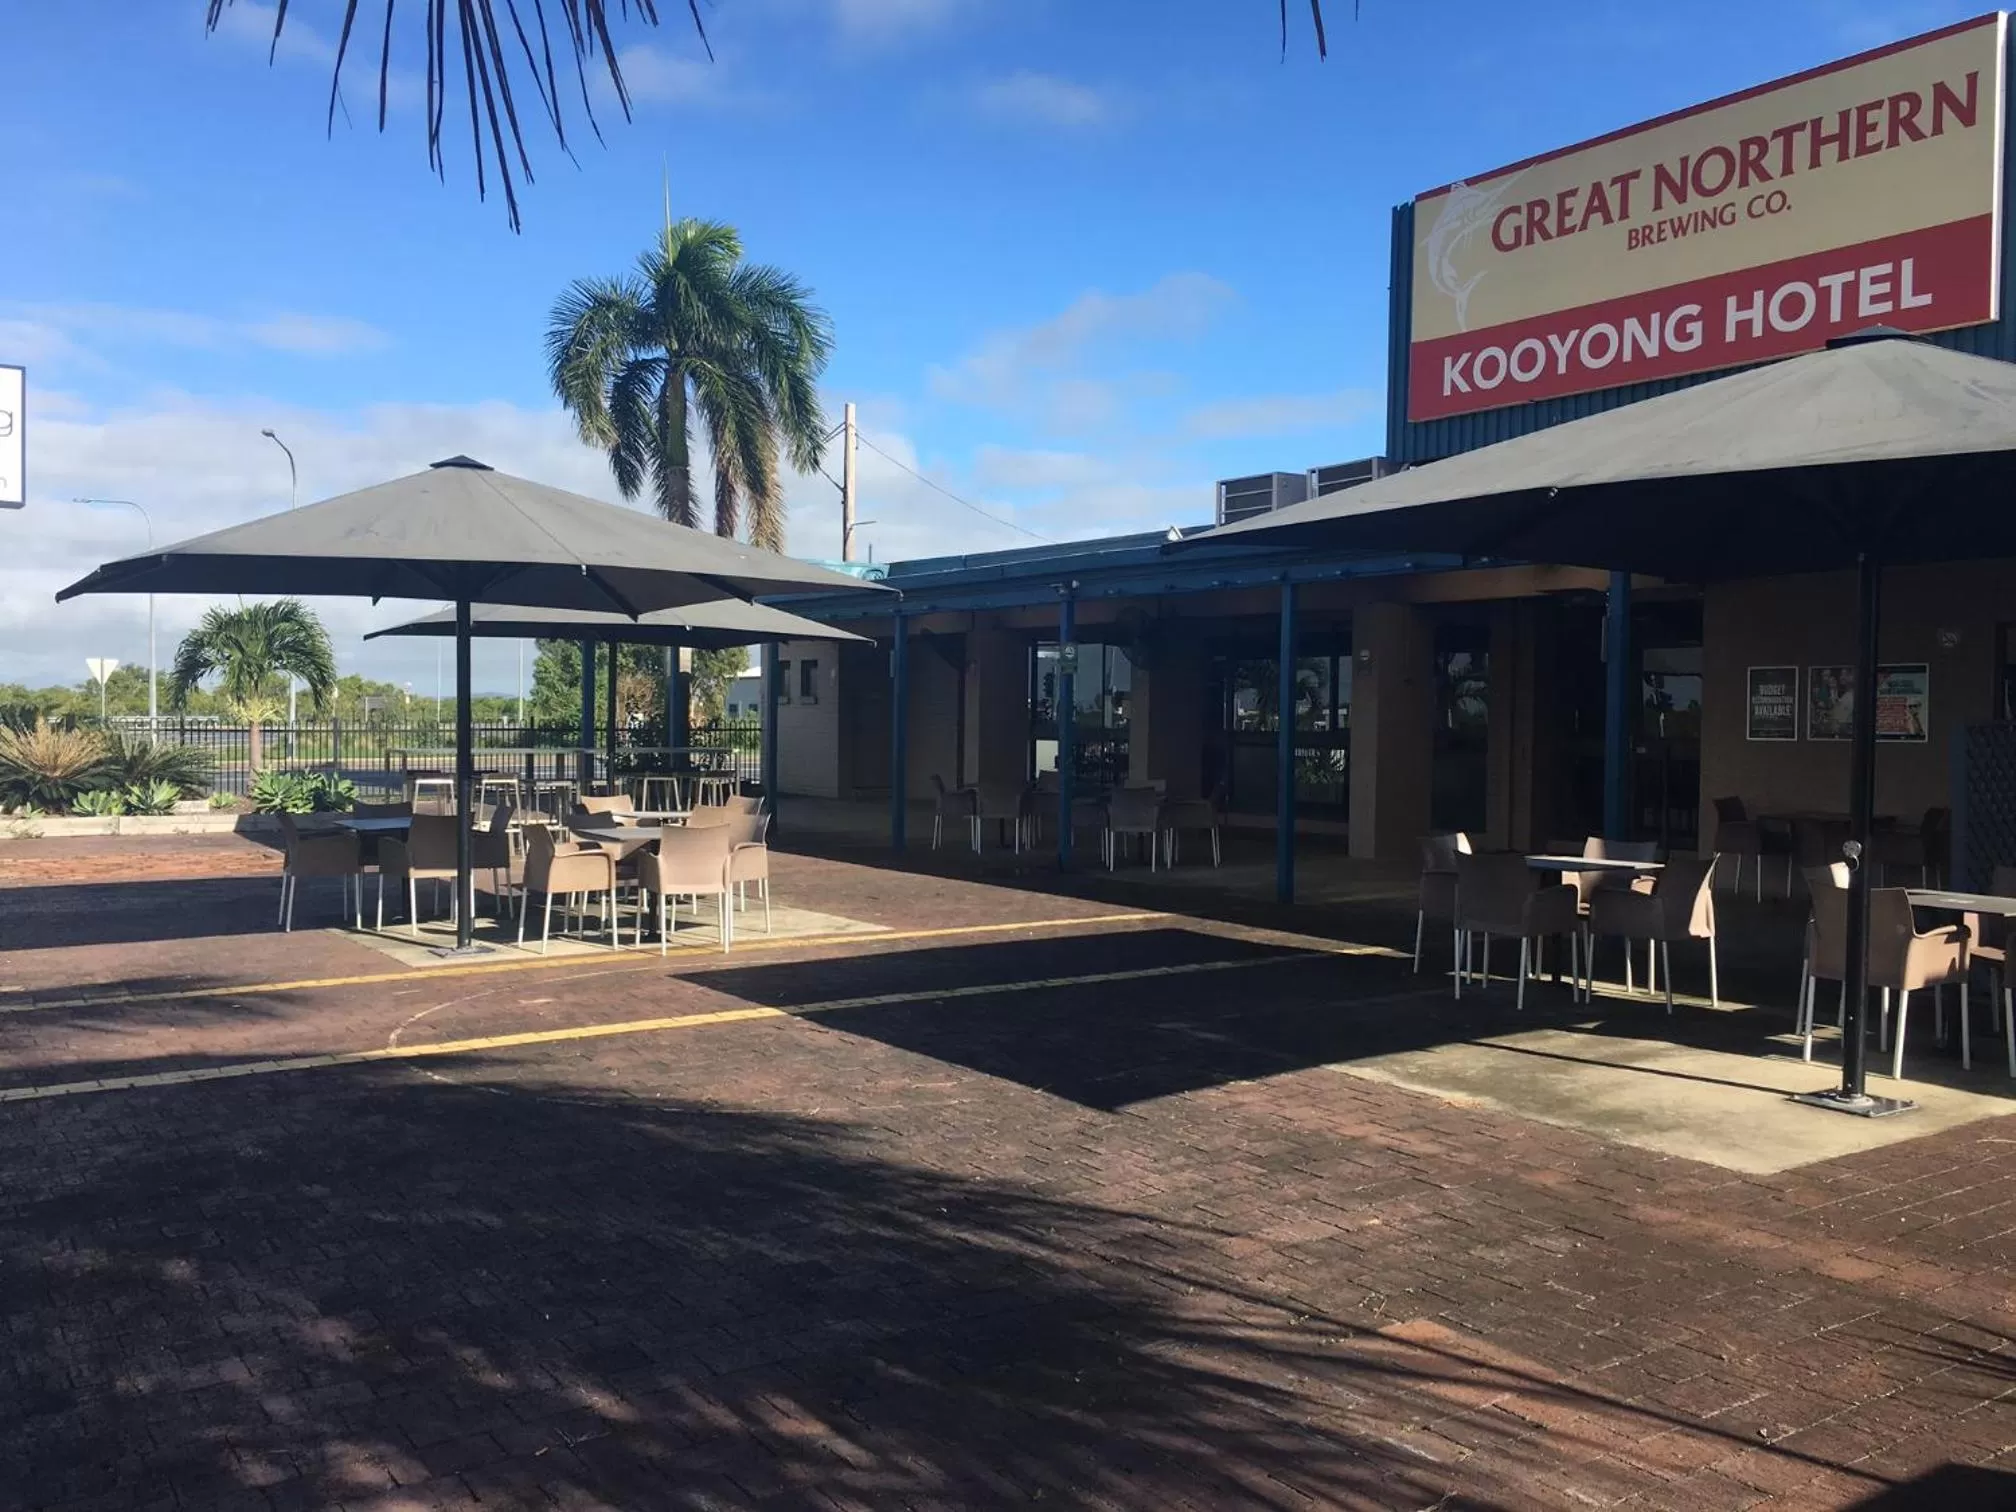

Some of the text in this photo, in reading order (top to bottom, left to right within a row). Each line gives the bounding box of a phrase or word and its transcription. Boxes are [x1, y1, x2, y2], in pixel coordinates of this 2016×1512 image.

[1491, 71, 1980, 253] GREAT NORTHERN
[1627, 190, 1793, 250] BREWING CO.
[1442, 258, 1933, 397] KOOYONG HOTEL
[1754, 704, 1792, 716] AVAILABLE
[1759, 684, 1786, 696] BUDGET
